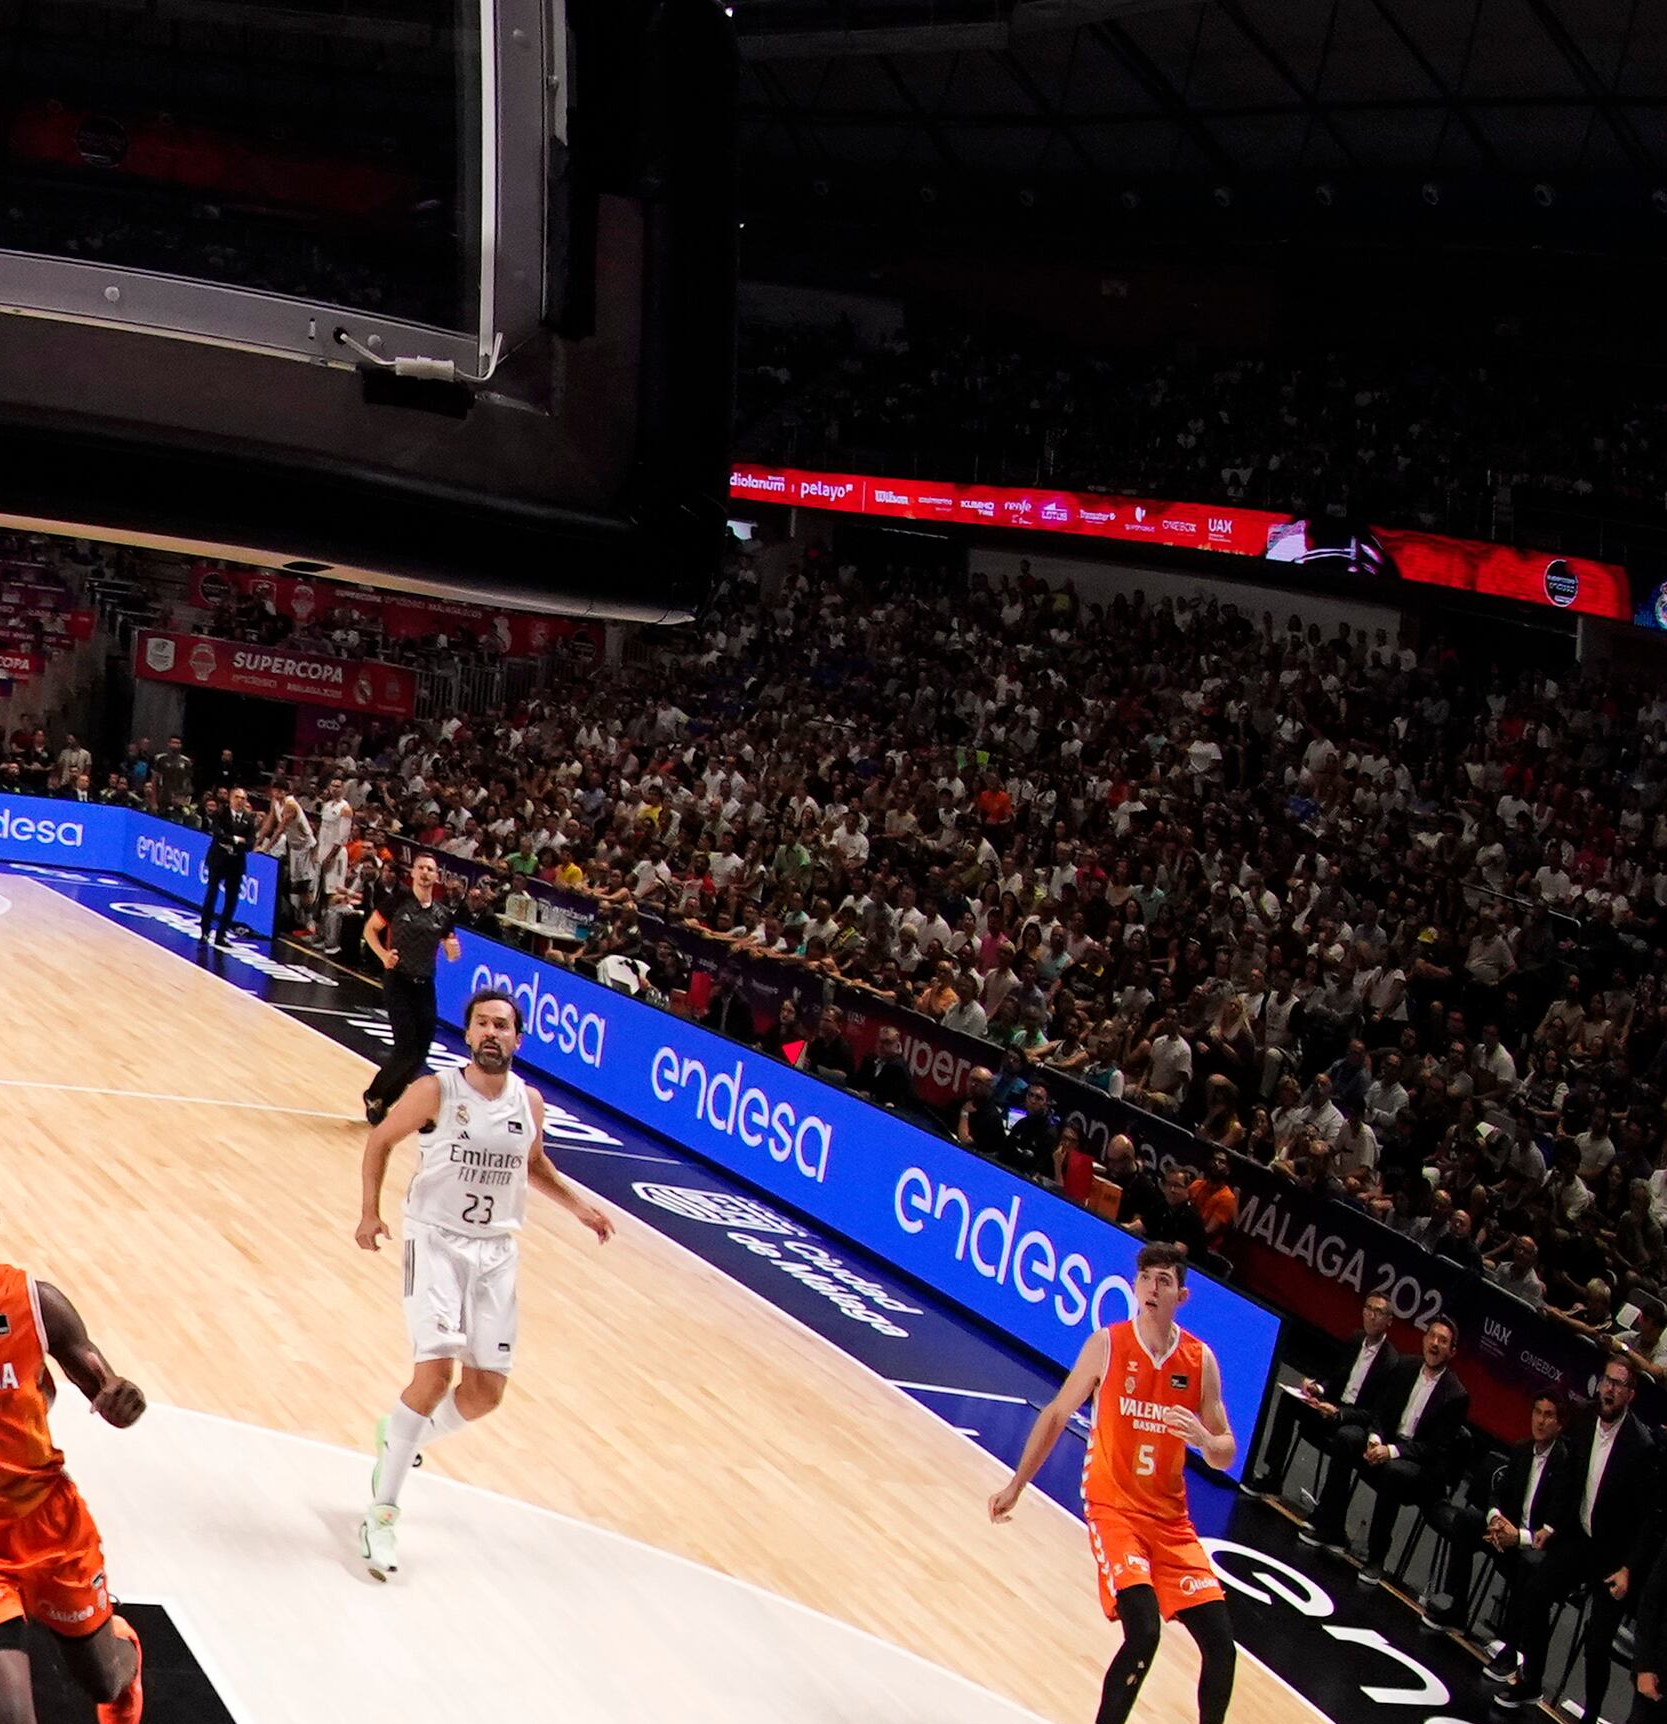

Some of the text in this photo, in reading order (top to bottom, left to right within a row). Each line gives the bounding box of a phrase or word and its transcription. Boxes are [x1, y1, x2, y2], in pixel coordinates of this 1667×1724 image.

[801, 482, 845, 501] pelayo
[1208, 518, 1232, 534] UAX
[233, 651, 343, 684] SUPERCOPA
[137, 835, 190, 877] endesa
[651, 1047, 831, 1183] endesa
[450, 1144, 524, 1169] Emirates
[459, 1166, 477, 1183] FLY
[462, 1193, 495, 1225] 23
[1235, 1193, 1368, 1293] MÁLAGA
[1483, 1316, 1513, 1346] UAX
[1520, 1350, 1564, 1383] ONEBOX
[1133, 1419, 1167, 1434] BASKET
[1136, 1445, 1156, 1476] 5
